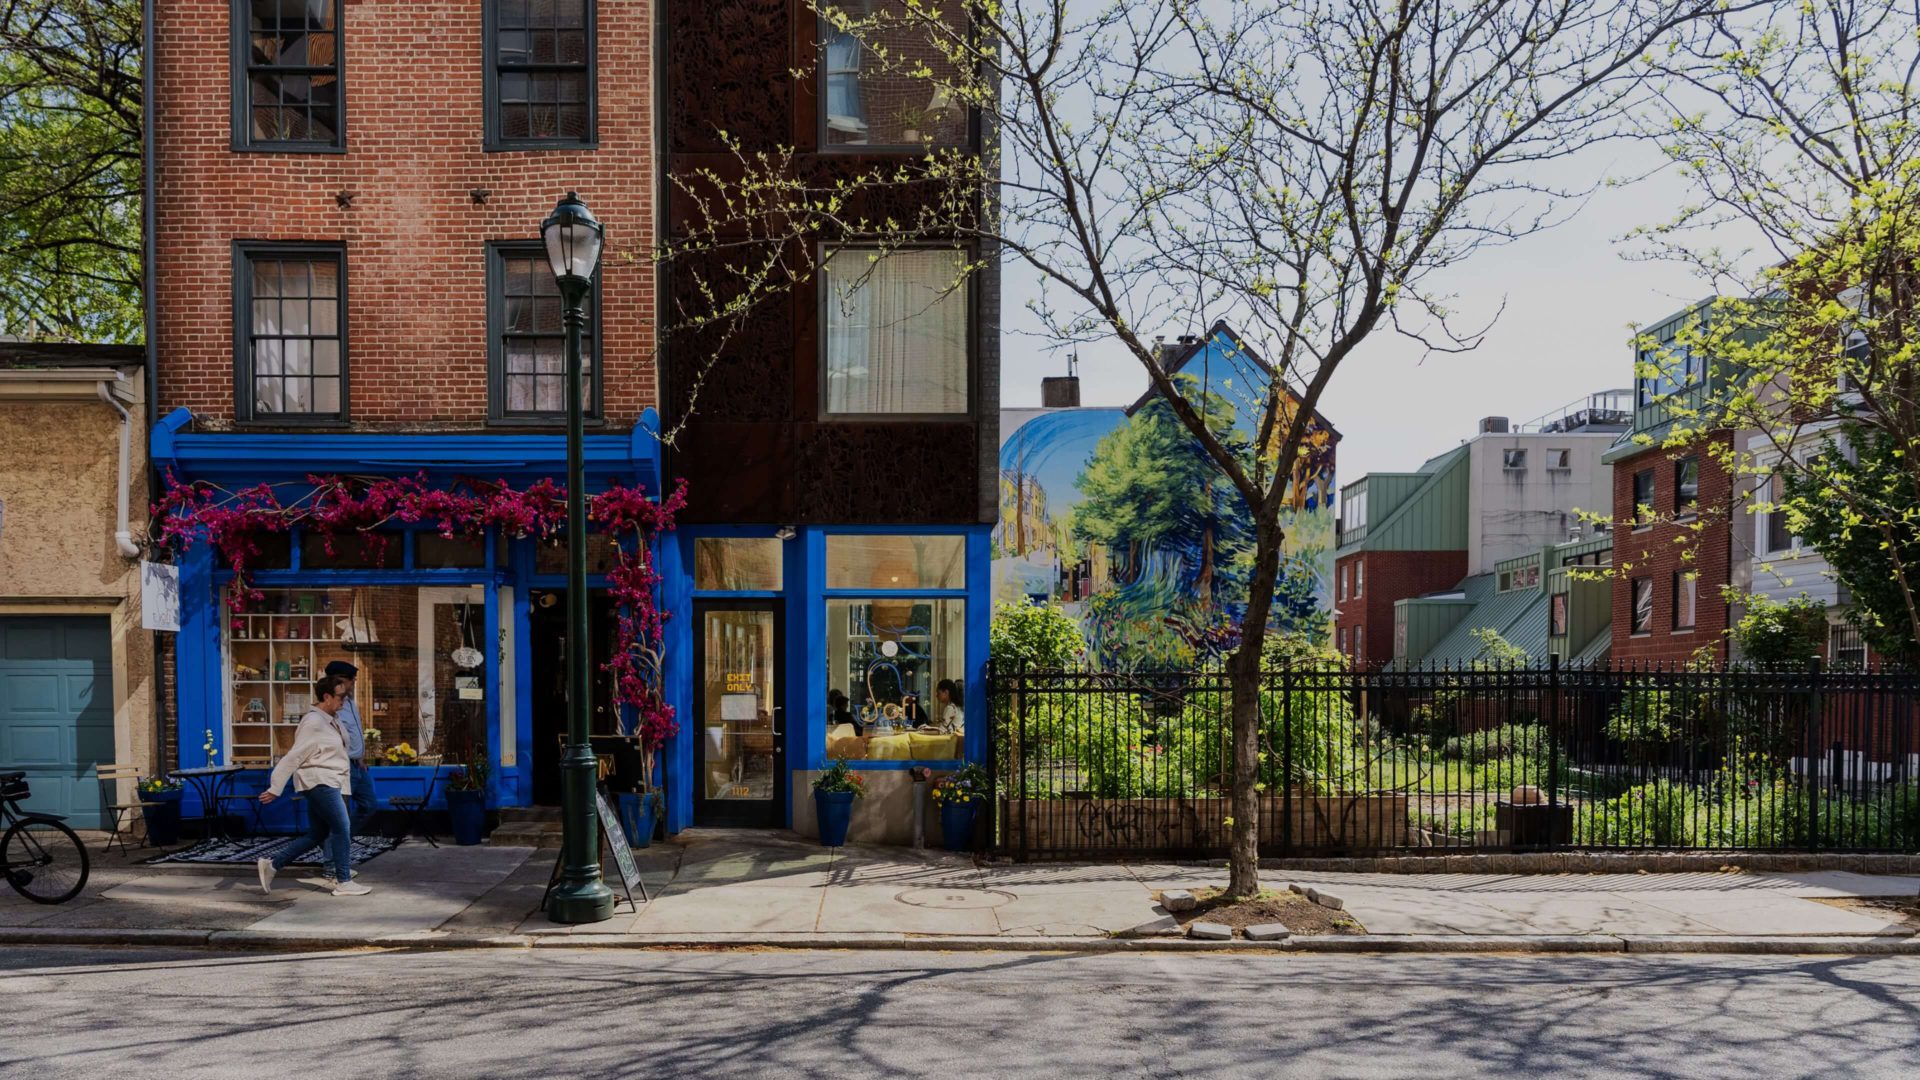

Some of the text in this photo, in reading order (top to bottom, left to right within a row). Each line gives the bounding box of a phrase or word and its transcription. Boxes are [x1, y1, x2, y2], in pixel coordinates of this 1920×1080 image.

[727, 673, 751, 682] EXIT
[727, 683, 752, 691] ONLY
[732, 787, 749, 796] 1112
